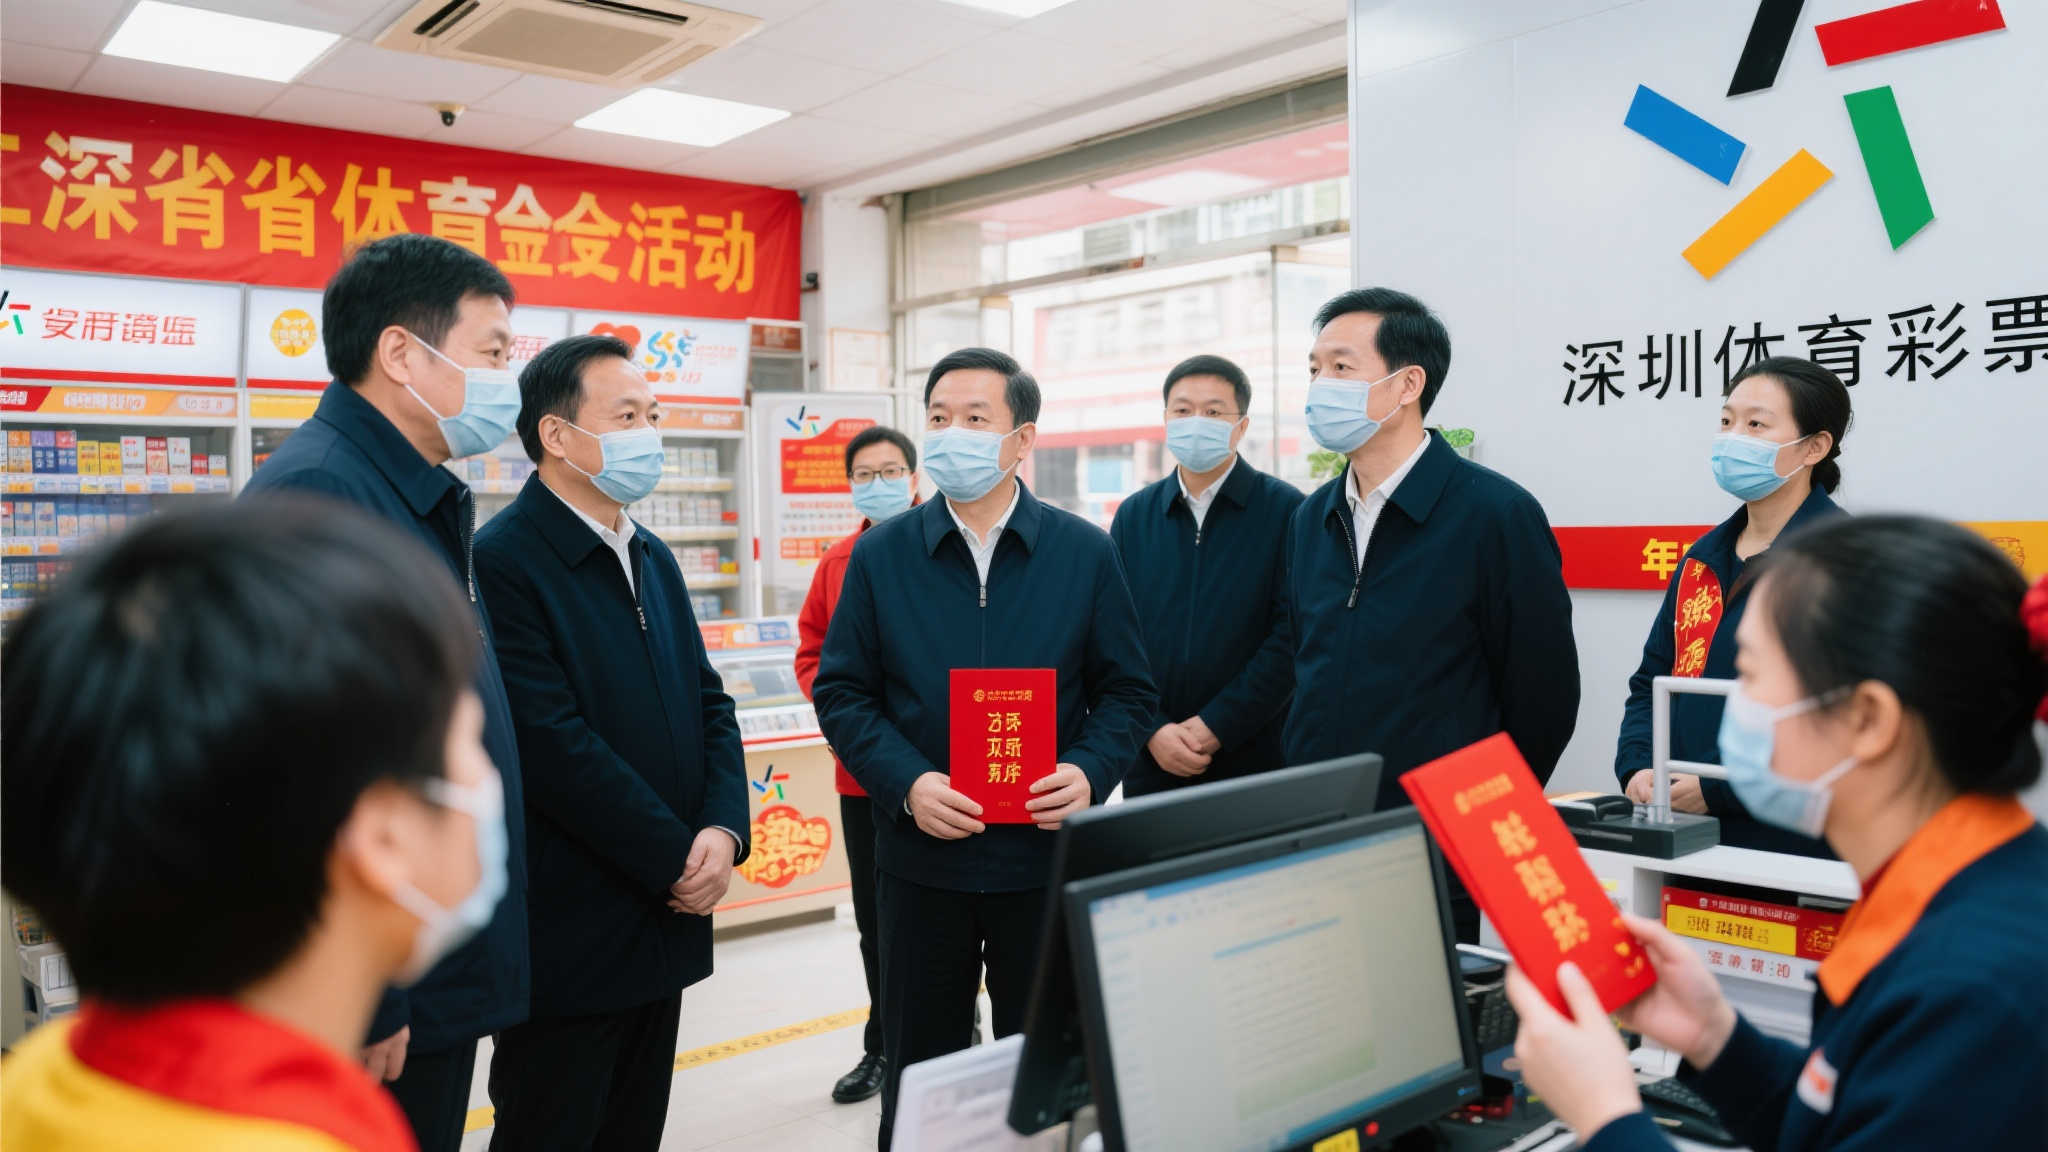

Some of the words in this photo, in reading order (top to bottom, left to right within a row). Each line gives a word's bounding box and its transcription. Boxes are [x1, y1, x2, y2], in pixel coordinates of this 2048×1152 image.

[1562, 294, 2048, 406] 深圳体育彩票
[1641, 537, 1693, 581] 年
